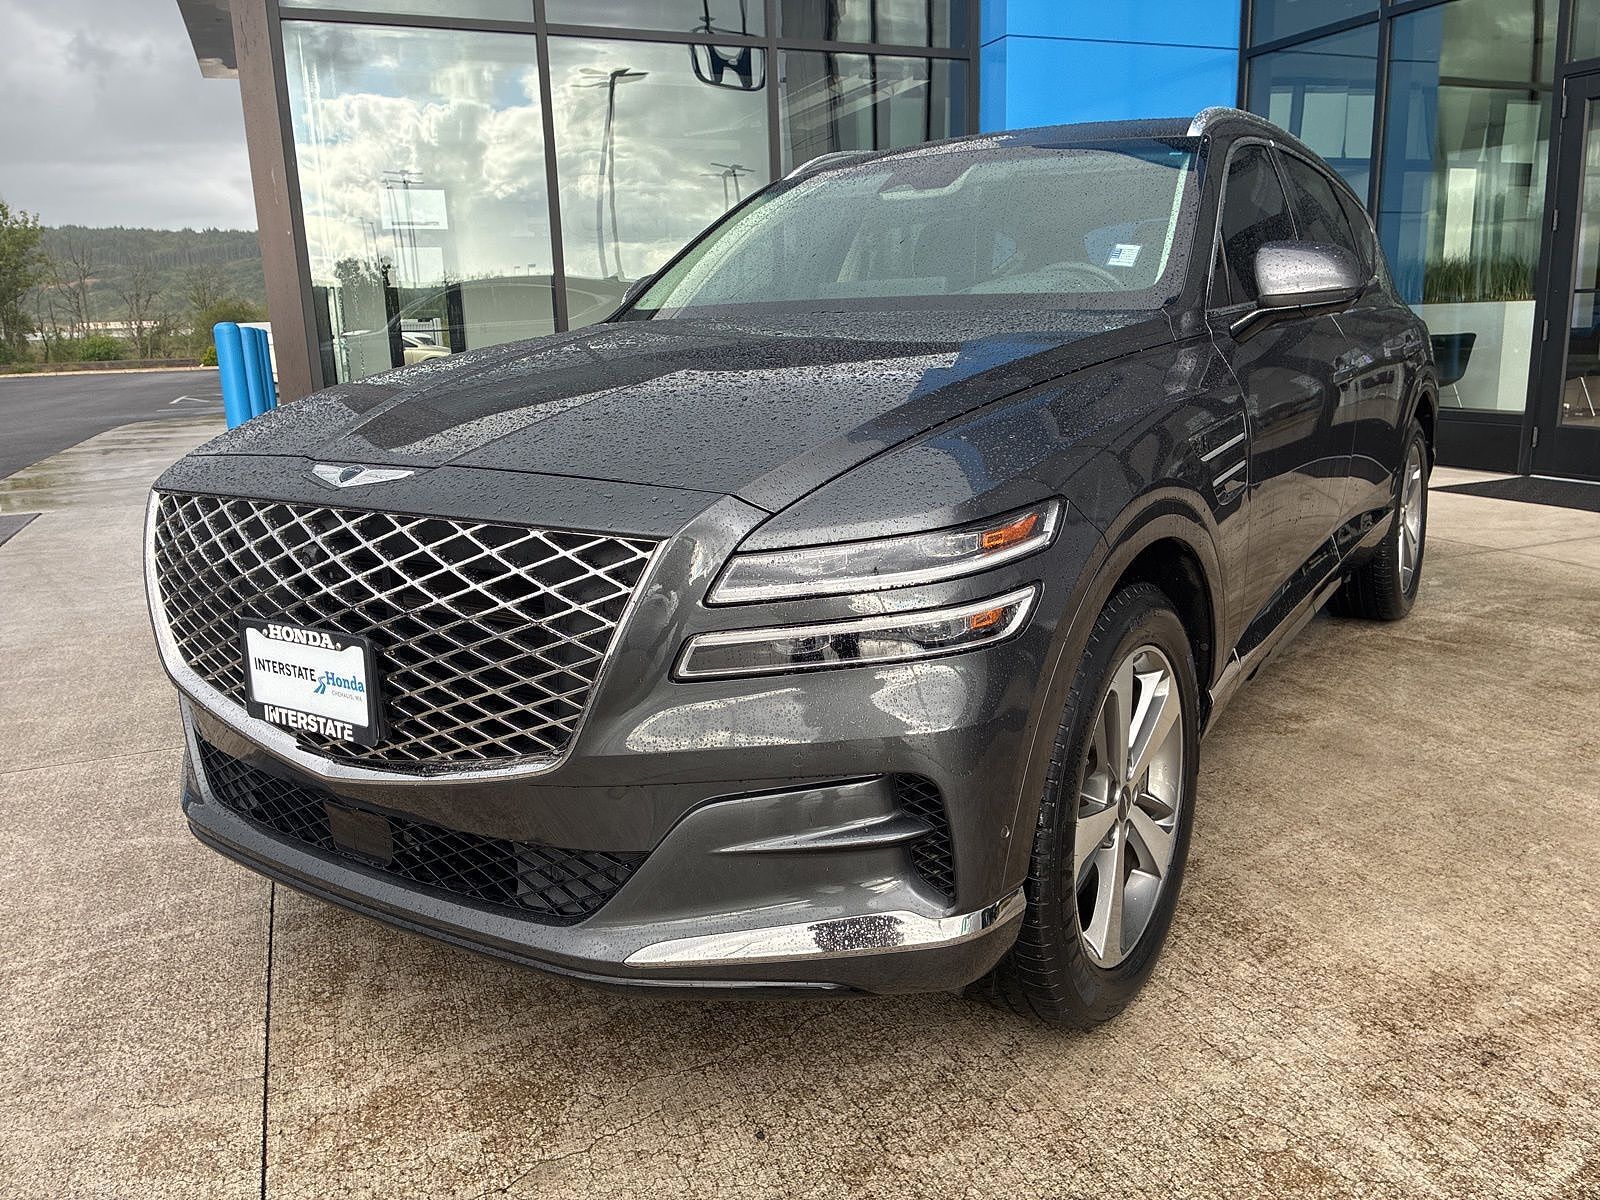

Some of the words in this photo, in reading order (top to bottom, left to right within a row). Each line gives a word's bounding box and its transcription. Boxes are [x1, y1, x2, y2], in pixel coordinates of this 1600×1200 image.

[267, 624, 335, 649] HONDA
[254, 657, 317, 682] INTERSTATE
[325, 671, 365, 693] Honda
[264, 705, 354, 742] INTERSTATE
